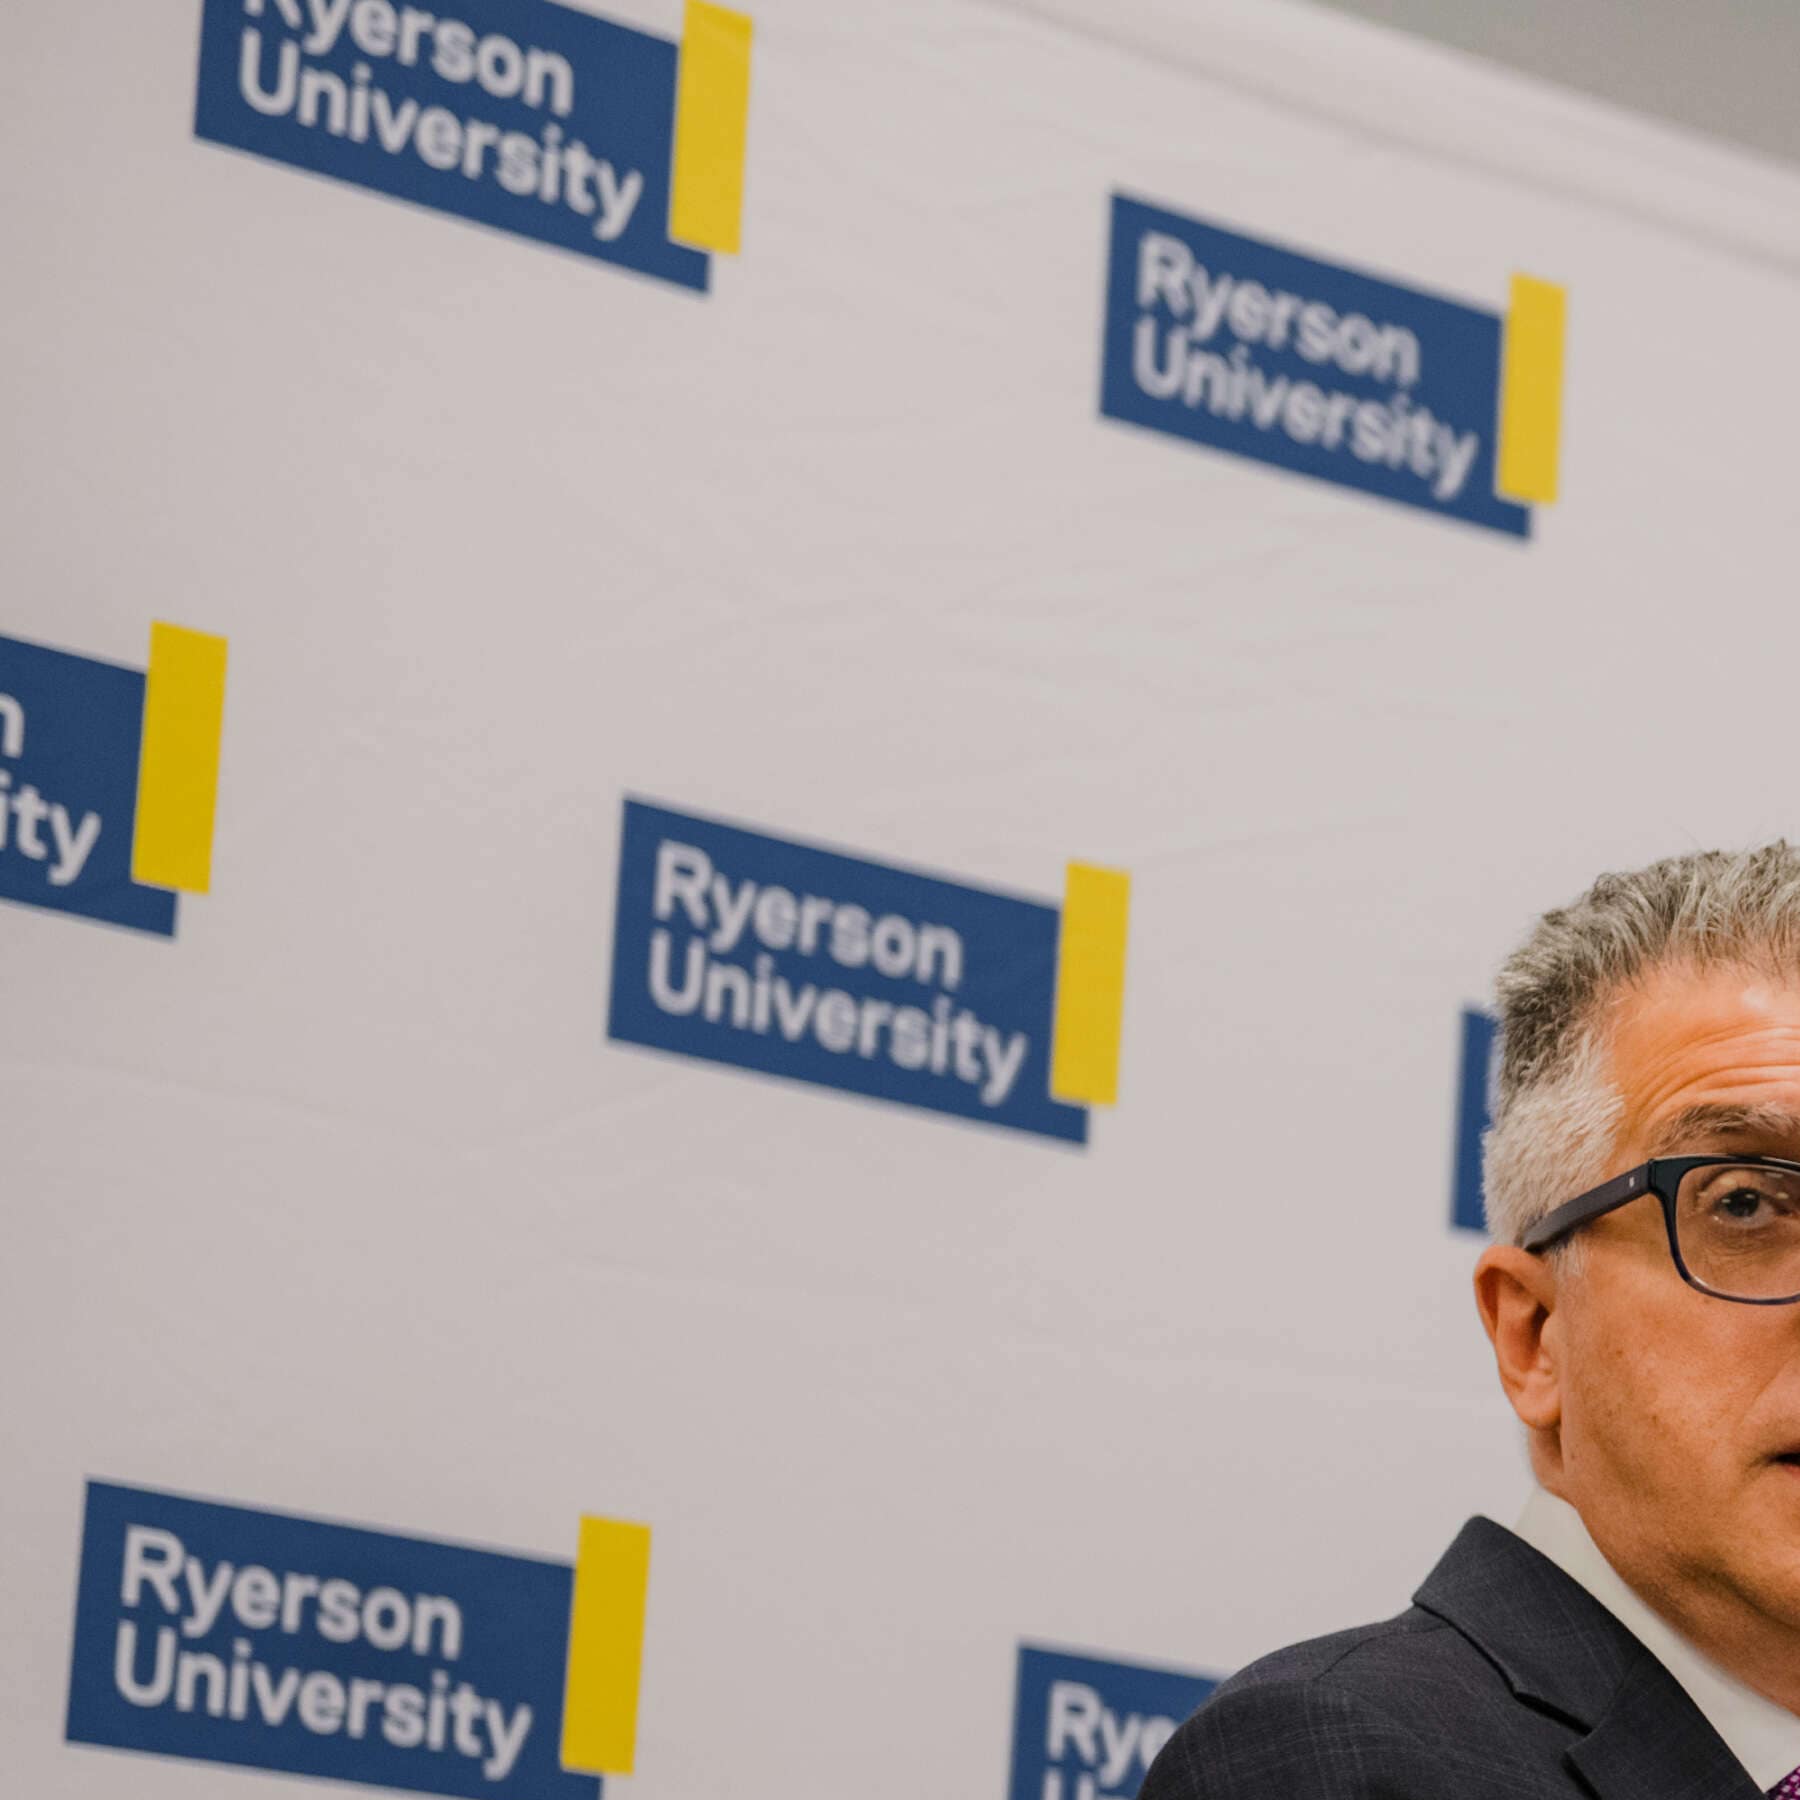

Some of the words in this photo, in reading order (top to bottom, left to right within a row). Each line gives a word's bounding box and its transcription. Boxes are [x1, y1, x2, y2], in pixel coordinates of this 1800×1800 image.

[238, 26, 645, 242] University
[244, 0, 575, 118] yerson
[1136, 230, 1421, 386] Ryerson
[1131, 313, 1480, 501] University
[654, 838, 964, 993] Ryerson
[648, 928, 1028, 1107] University
[120, 1522, 463, 1661] Ryerson
[114, 1617, 534, 1782] University
